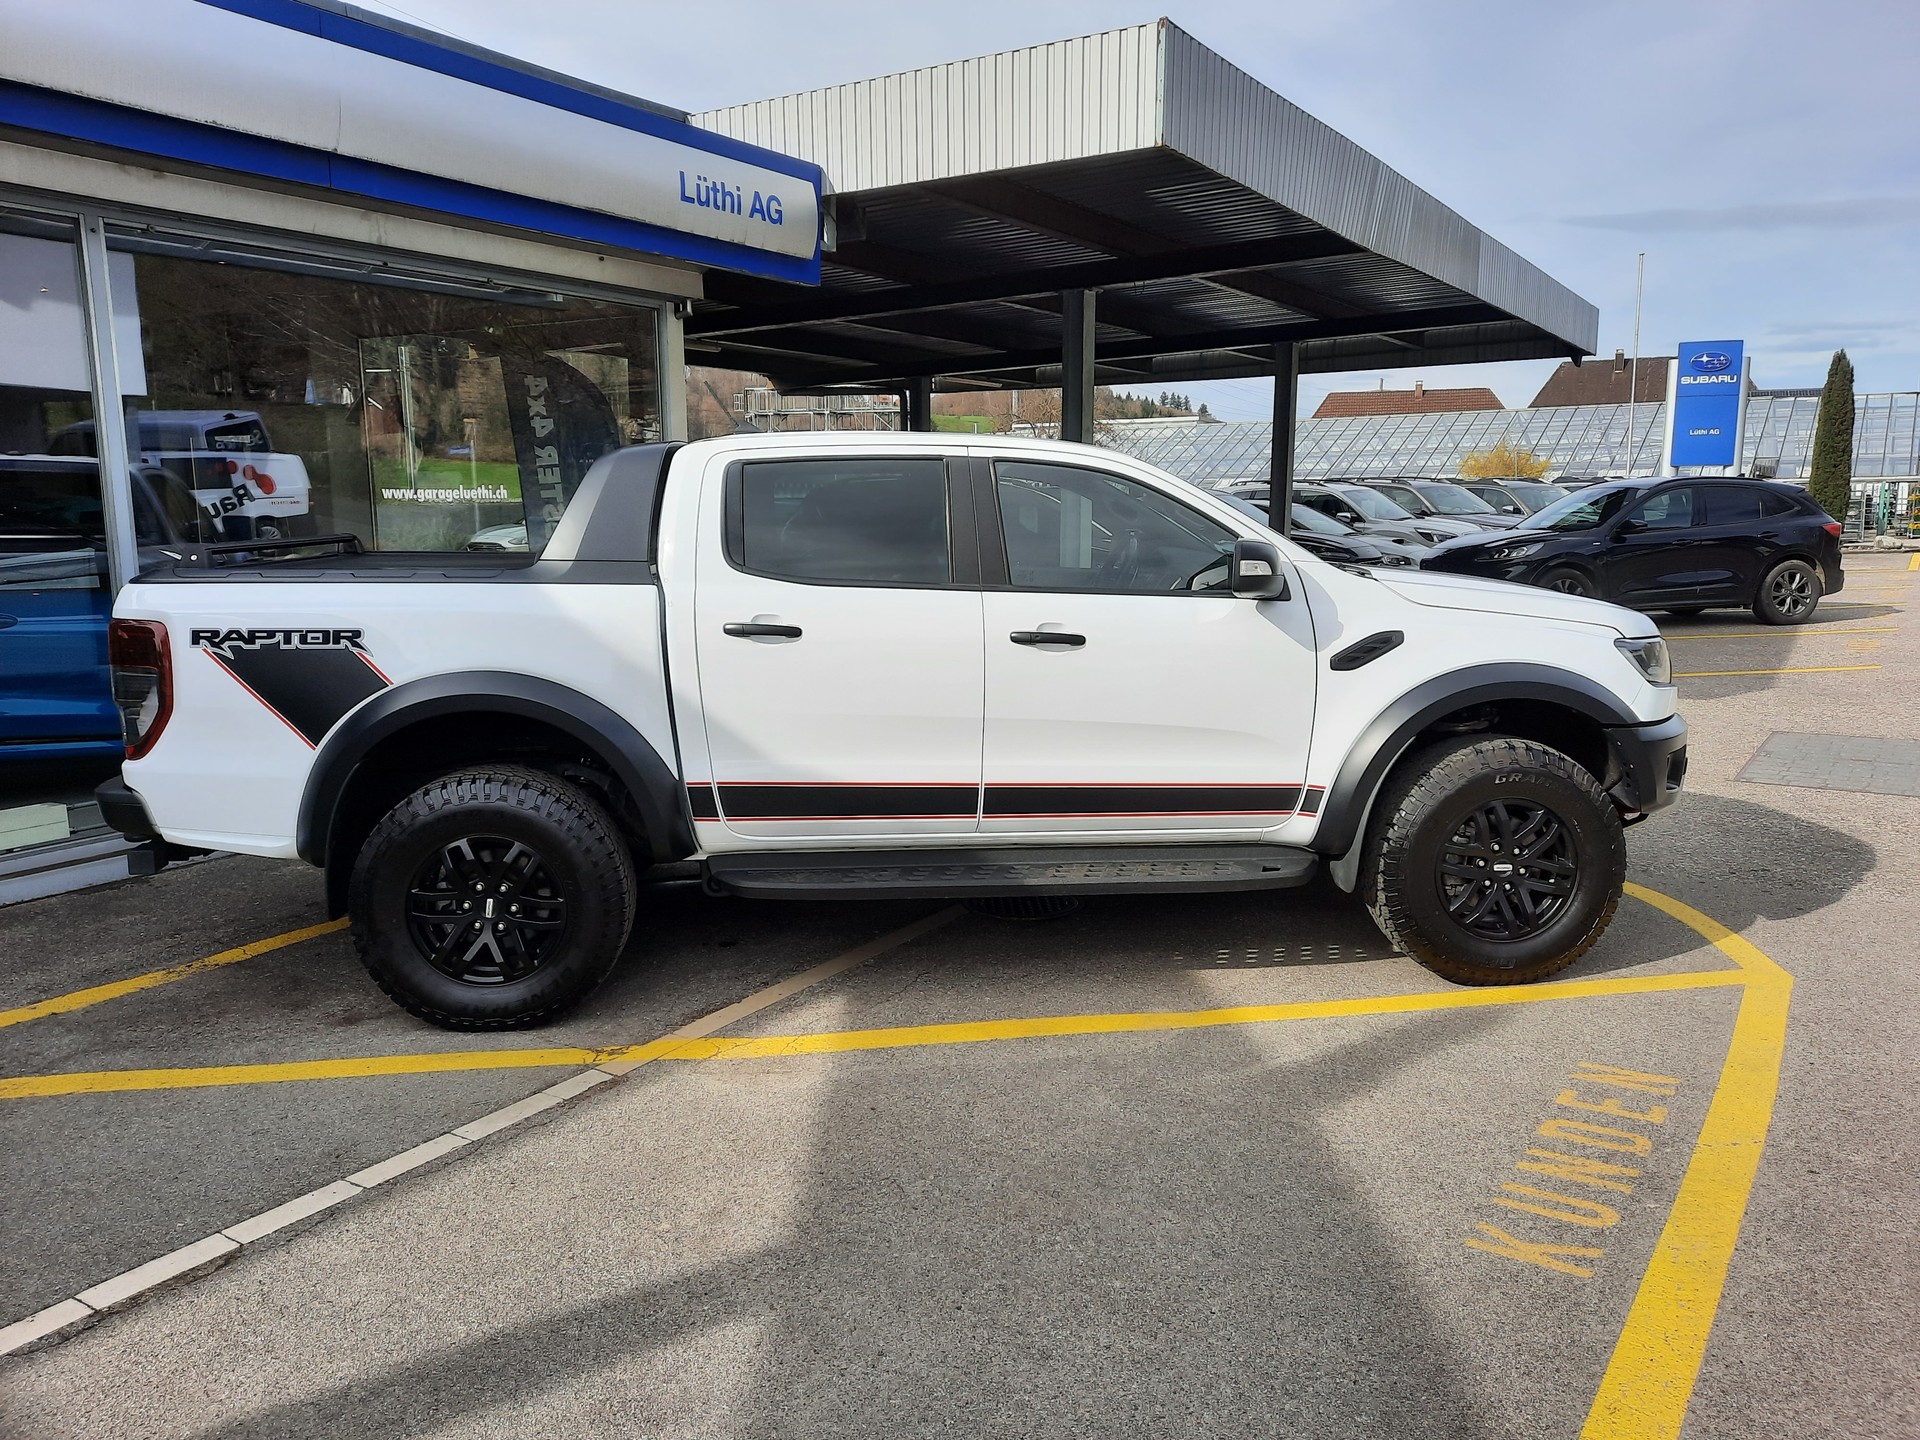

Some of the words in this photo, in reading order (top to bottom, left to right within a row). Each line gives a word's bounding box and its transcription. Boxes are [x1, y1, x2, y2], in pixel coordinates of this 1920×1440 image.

[679, 170, 742, 215] Lüthi
[748, 190, 783, 226] AG
[1680, 375, 1737, 385] SUBARU
[381, 484, 508, 502] www.garageluethi.ch
[190, 627, 374, 659] RAPTOR
[1464, 1060, 1681, 1279] KUNDEN
